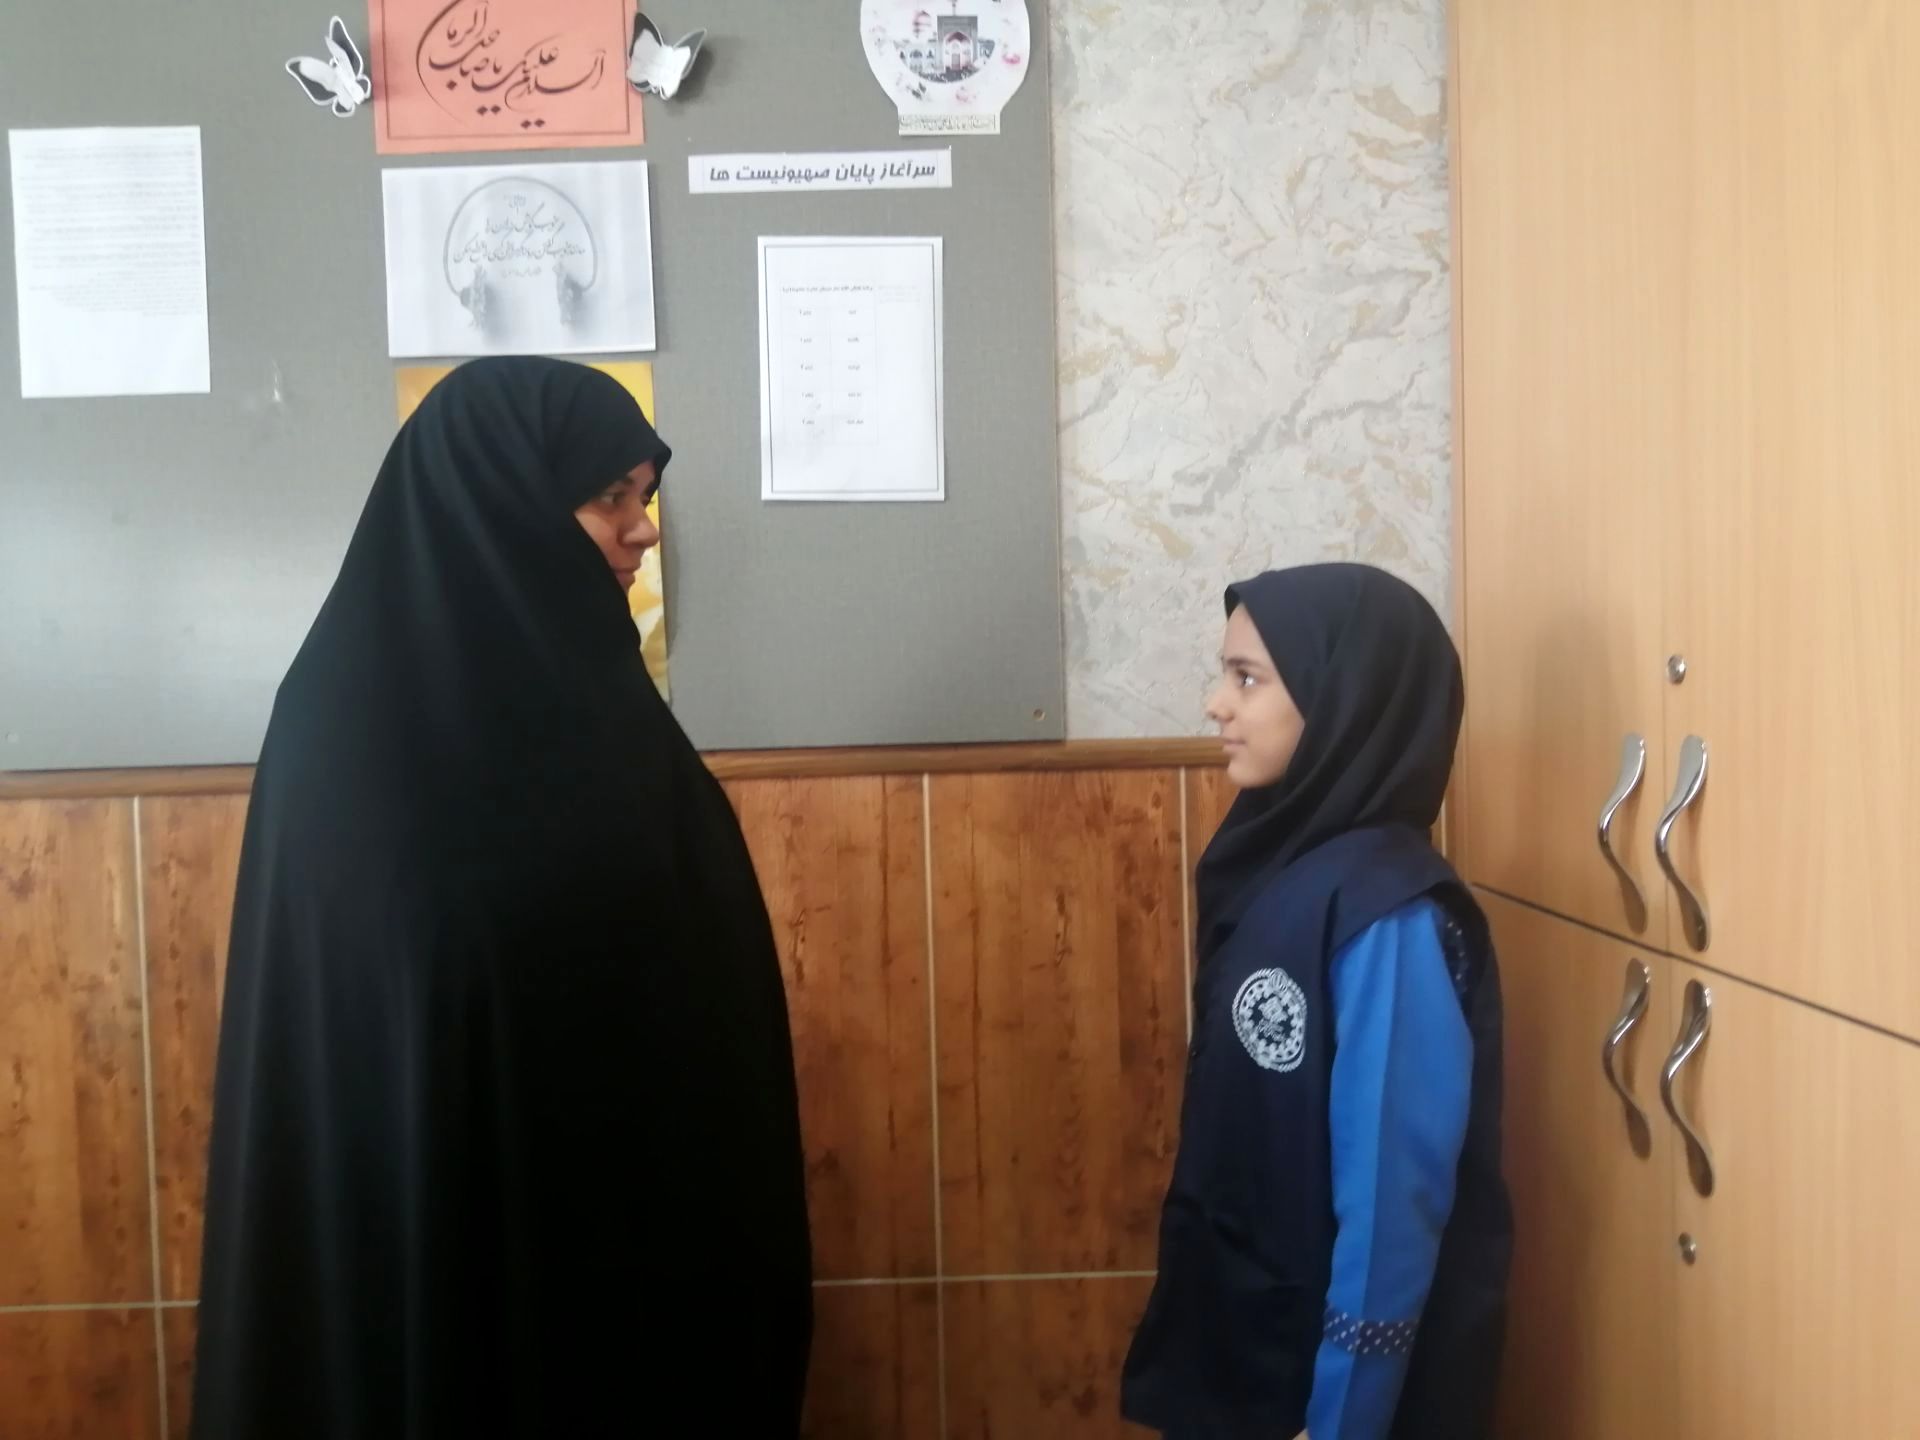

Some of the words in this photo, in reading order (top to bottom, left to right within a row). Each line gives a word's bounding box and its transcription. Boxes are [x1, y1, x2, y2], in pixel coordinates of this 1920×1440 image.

[708, 166, 730, 182] ها
[735, 165, 831, 185] صهیونیست
[834, 163, 876, 185] پایان
